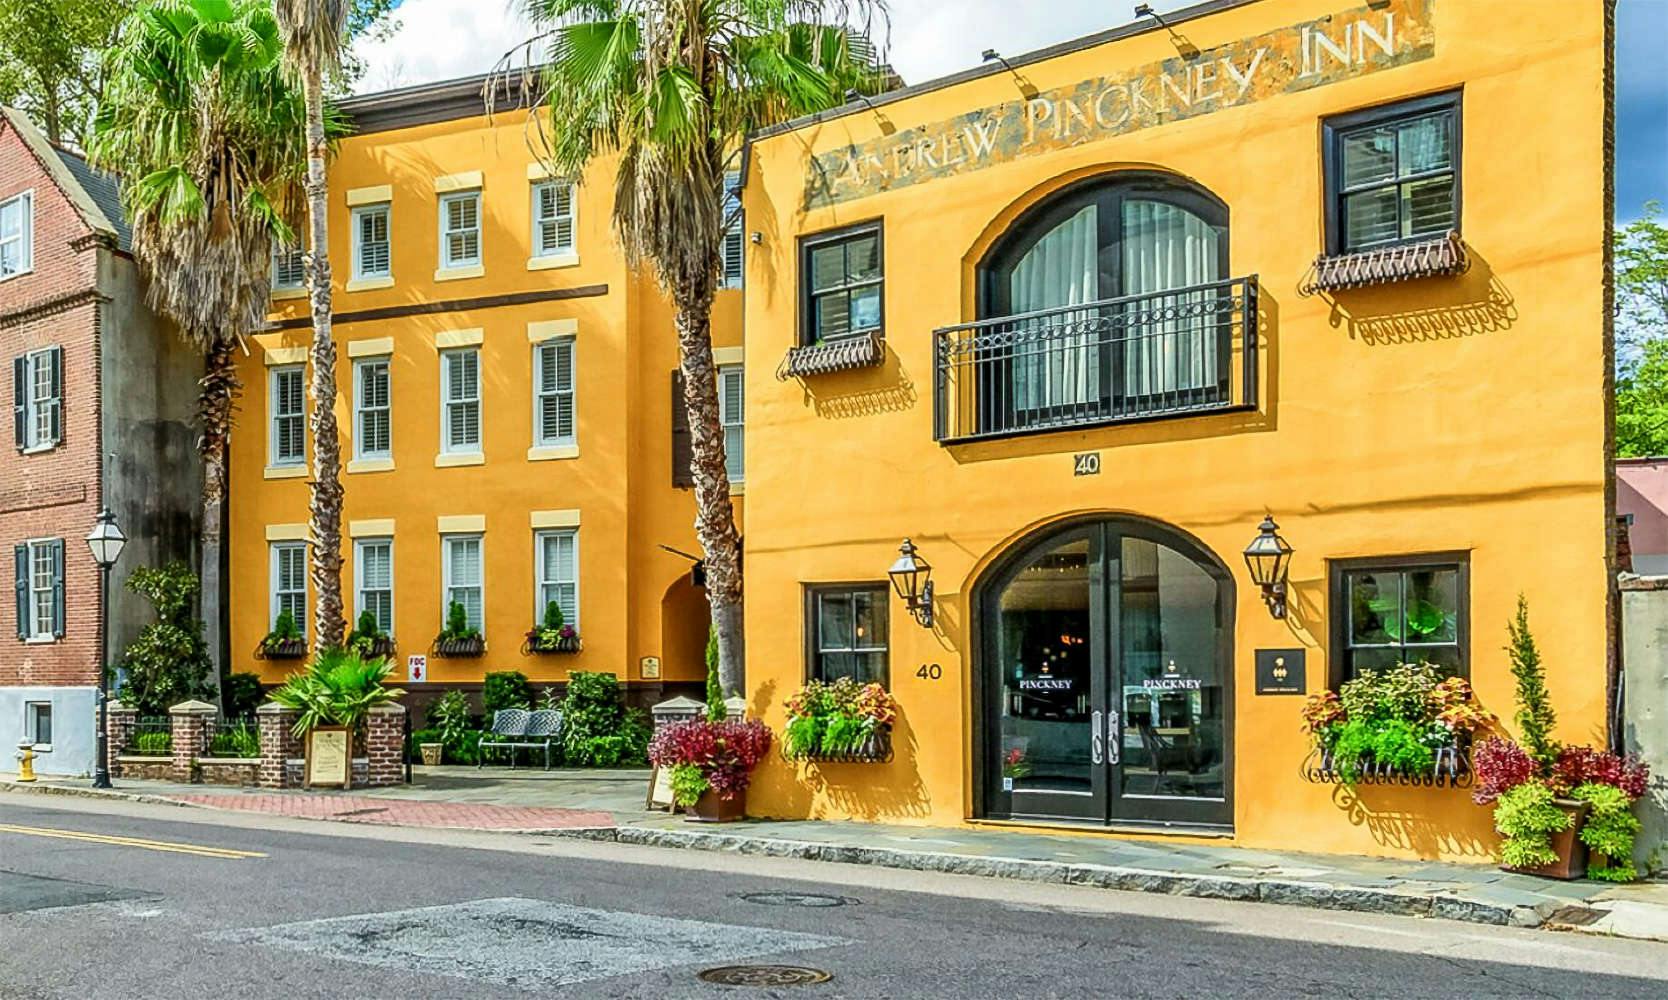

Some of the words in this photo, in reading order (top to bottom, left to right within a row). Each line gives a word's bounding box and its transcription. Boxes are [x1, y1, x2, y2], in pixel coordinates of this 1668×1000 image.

[831, 117, 1003, 196] ANDREW
[1023, 47, 1267, 147] PINCKNEY
[1299, 12, 1395, 78] INN
[1075, 454, 1099, 474] 40
[916, 663, 942, 680] 40
[1019, 679, 1073, 689] PINCKNEY
[1143, 679, 1202, 689] PINCKNEY
